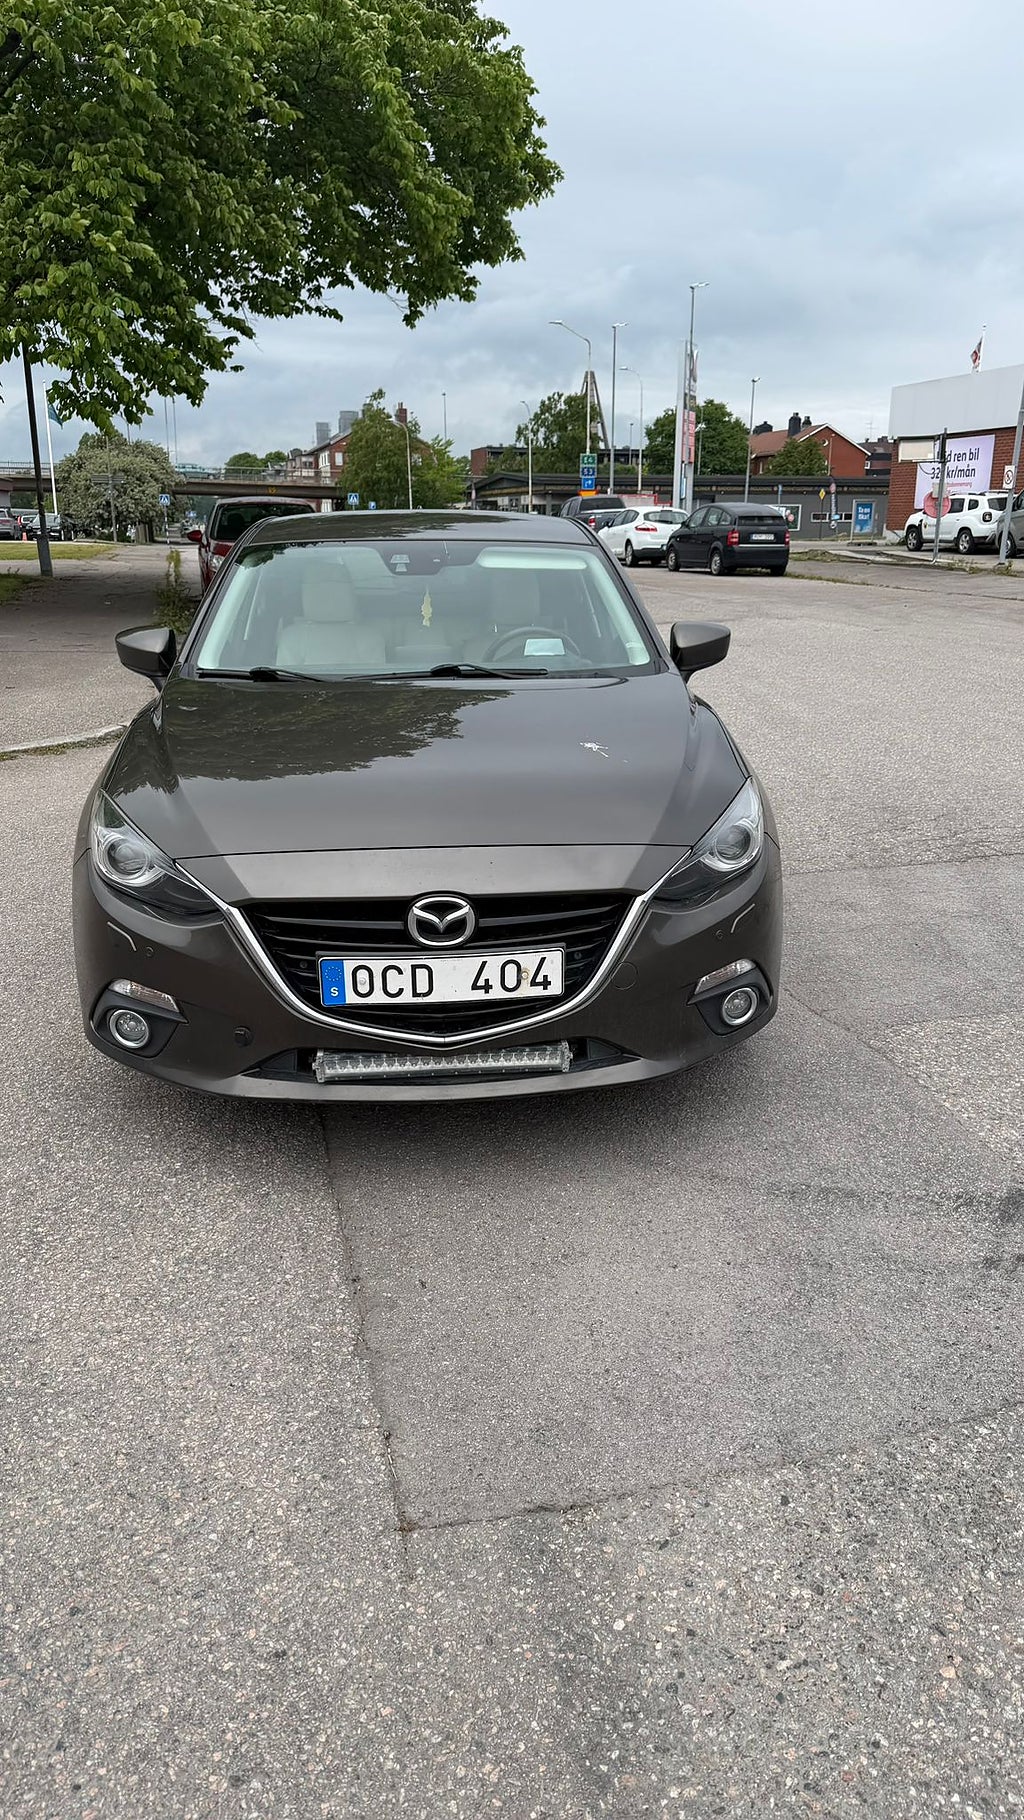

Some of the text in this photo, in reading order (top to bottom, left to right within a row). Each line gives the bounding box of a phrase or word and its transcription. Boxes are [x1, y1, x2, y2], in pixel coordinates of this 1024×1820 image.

[953, 452, 967, 462] ren
[968, 447, 980, 461] bil
[946, 463, 976, 479] kr/mån
[351, 956, 552, 999] OCD 404
[330, 987, 339, 997] S
